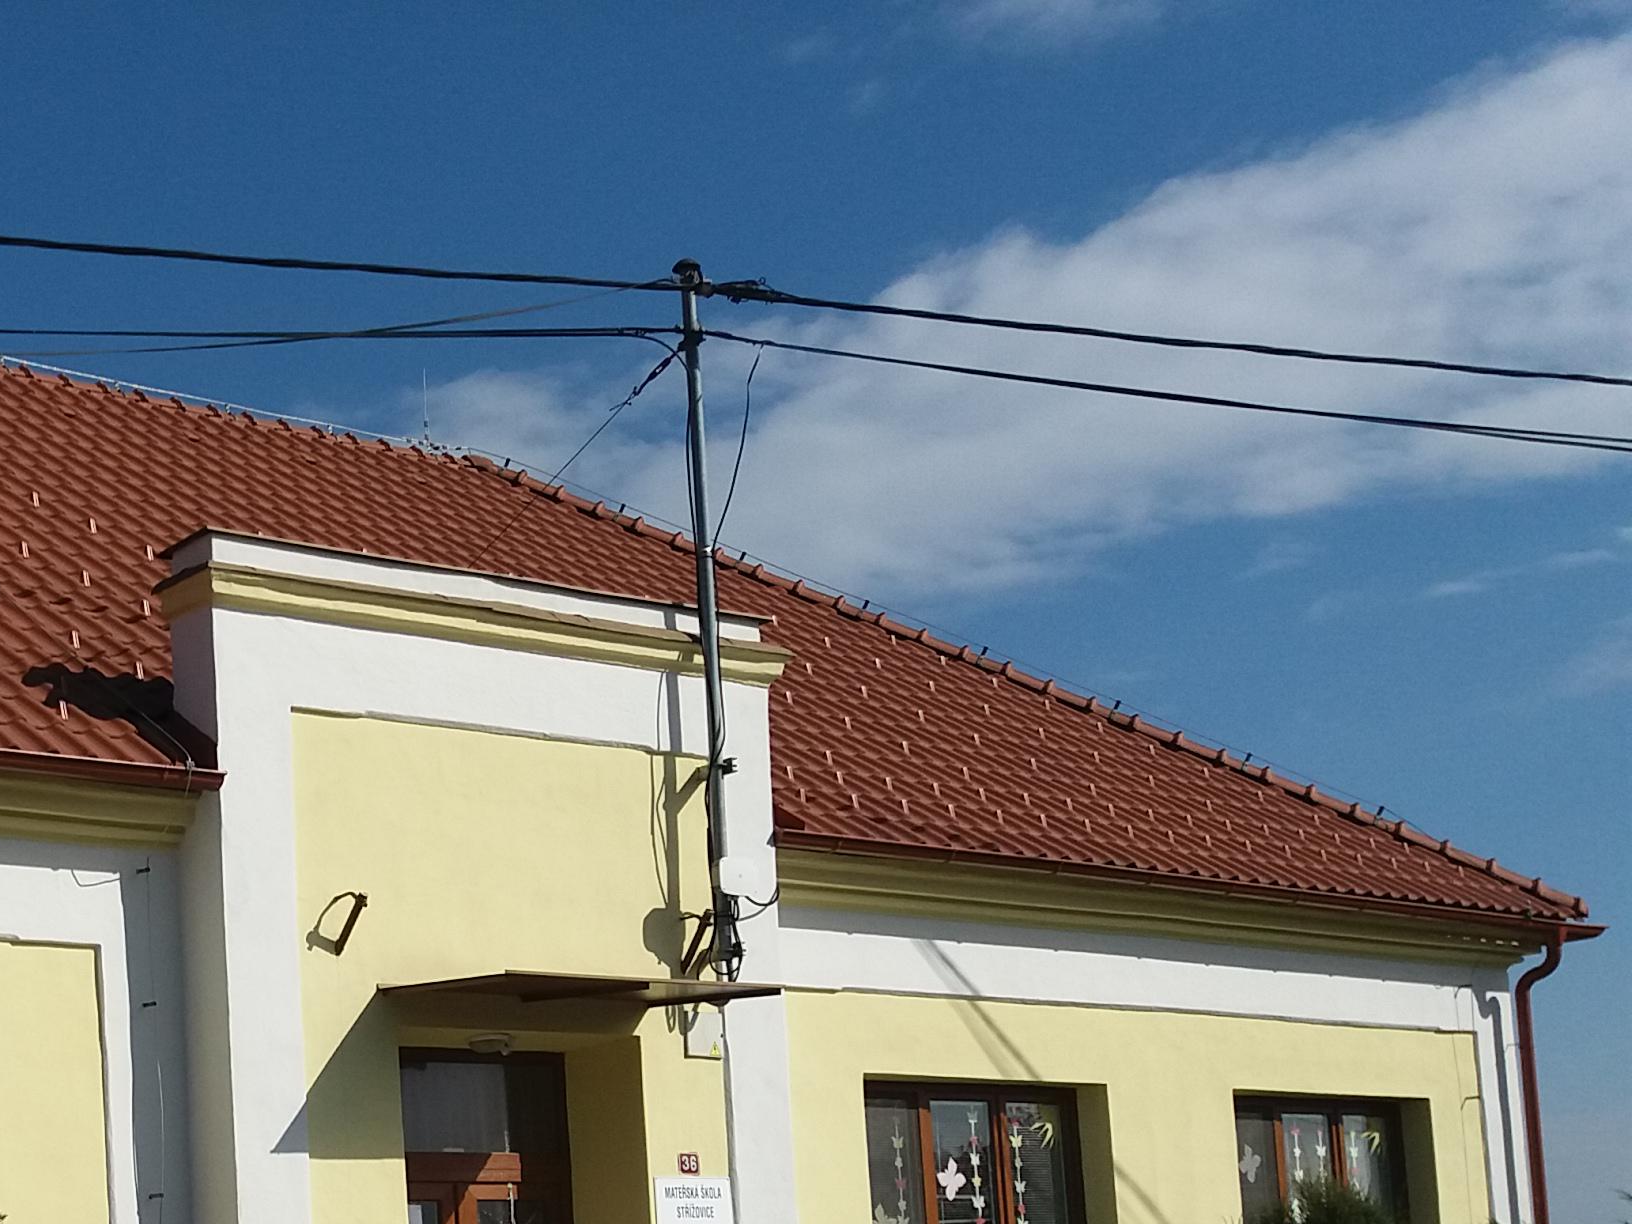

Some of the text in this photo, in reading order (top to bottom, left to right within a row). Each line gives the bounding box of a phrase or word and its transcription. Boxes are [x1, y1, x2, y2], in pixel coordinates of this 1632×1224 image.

[681, 1155, 698, 1172] 36
[664, 1184, 722, 1199] MATEŘSKÁ ŠKOLA
[677, 1203, 715, 1218] STŘÍŽOVICE
